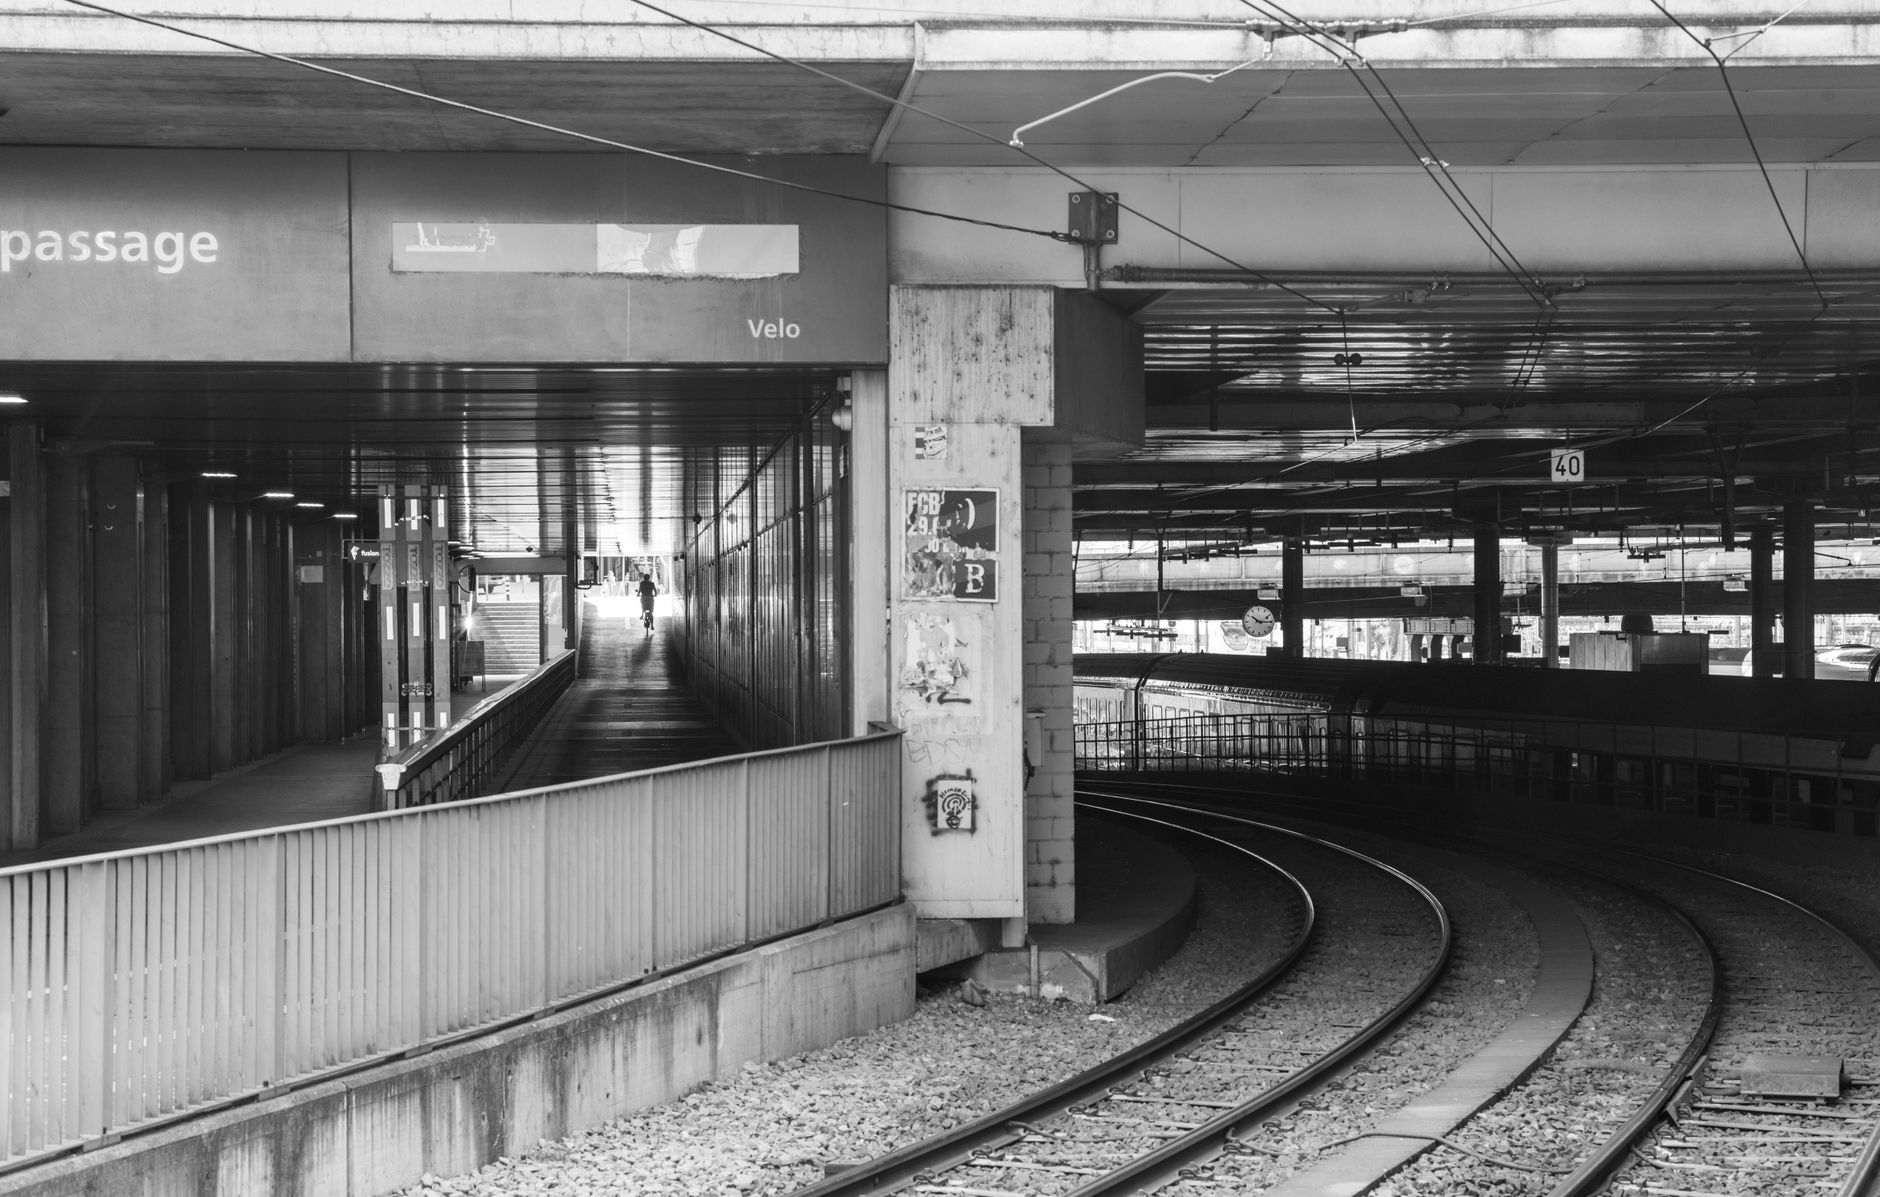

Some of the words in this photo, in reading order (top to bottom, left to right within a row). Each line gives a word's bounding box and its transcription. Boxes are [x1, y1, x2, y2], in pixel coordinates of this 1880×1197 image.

[0, 230, 219, 274] passage
[747, 317, 801, 339] Velo
[1555, 455, 1580, 476] 40
[361, 549, 380, 557] fusion
